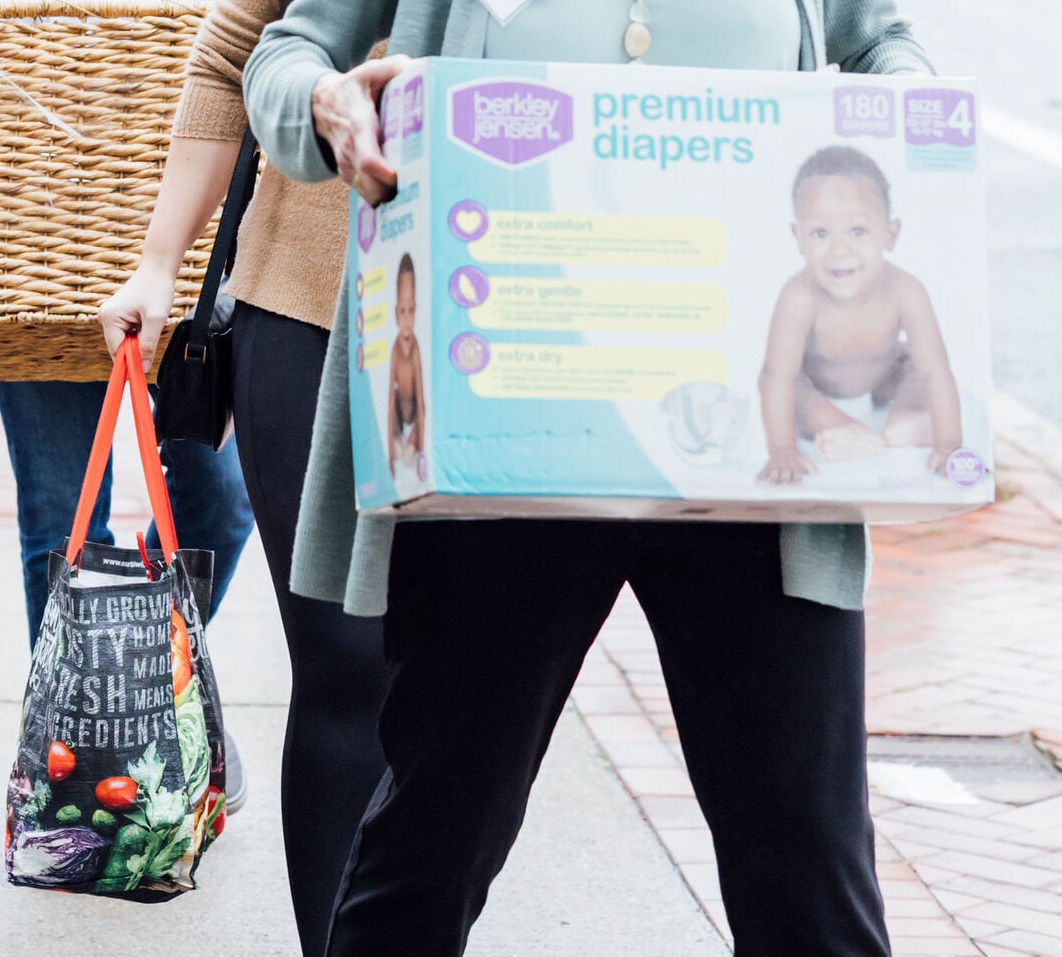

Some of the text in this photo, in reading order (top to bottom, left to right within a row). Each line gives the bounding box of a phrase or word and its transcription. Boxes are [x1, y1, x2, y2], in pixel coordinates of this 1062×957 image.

[473, 90, 560, 121] berkley
[593, 88, 780, 127] premium
[840, 94, 889, 119] 180
[908, 99, 943, 113] SIZE
[948, 98, 973, 137] 4
[593, 125, 754, 169] diapers
[496, 218, 594, 232] extra comfort
[497, 284, 534, 296] extra
[498, 350, 563, 364] extra dry
[133, 653, 173, 679] MADE
[134, 684, 173, 711] MEALS
